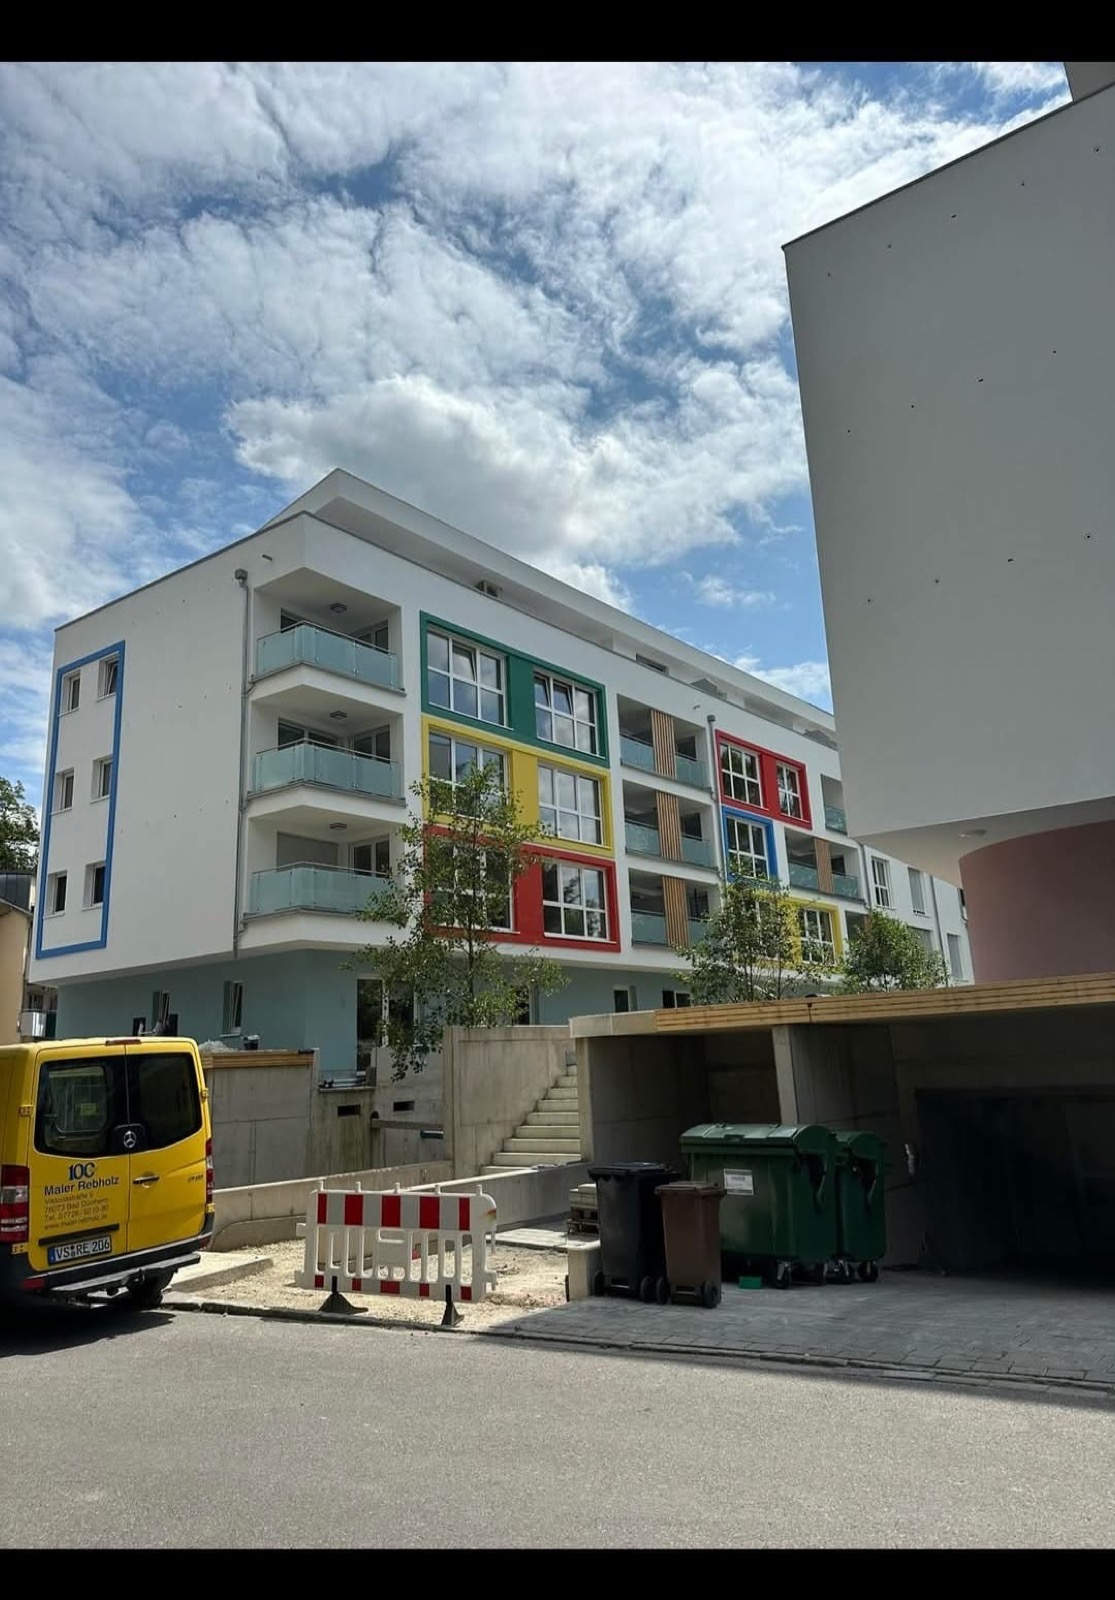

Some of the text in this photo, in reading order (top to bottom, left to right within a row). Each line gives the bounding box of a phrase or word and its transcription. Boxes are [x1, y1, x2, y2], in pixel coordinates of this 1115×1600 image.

[44, 1176, 120, 1196] Maler Rebholz
[56, 1238, 110, 1259] VS RE 206
